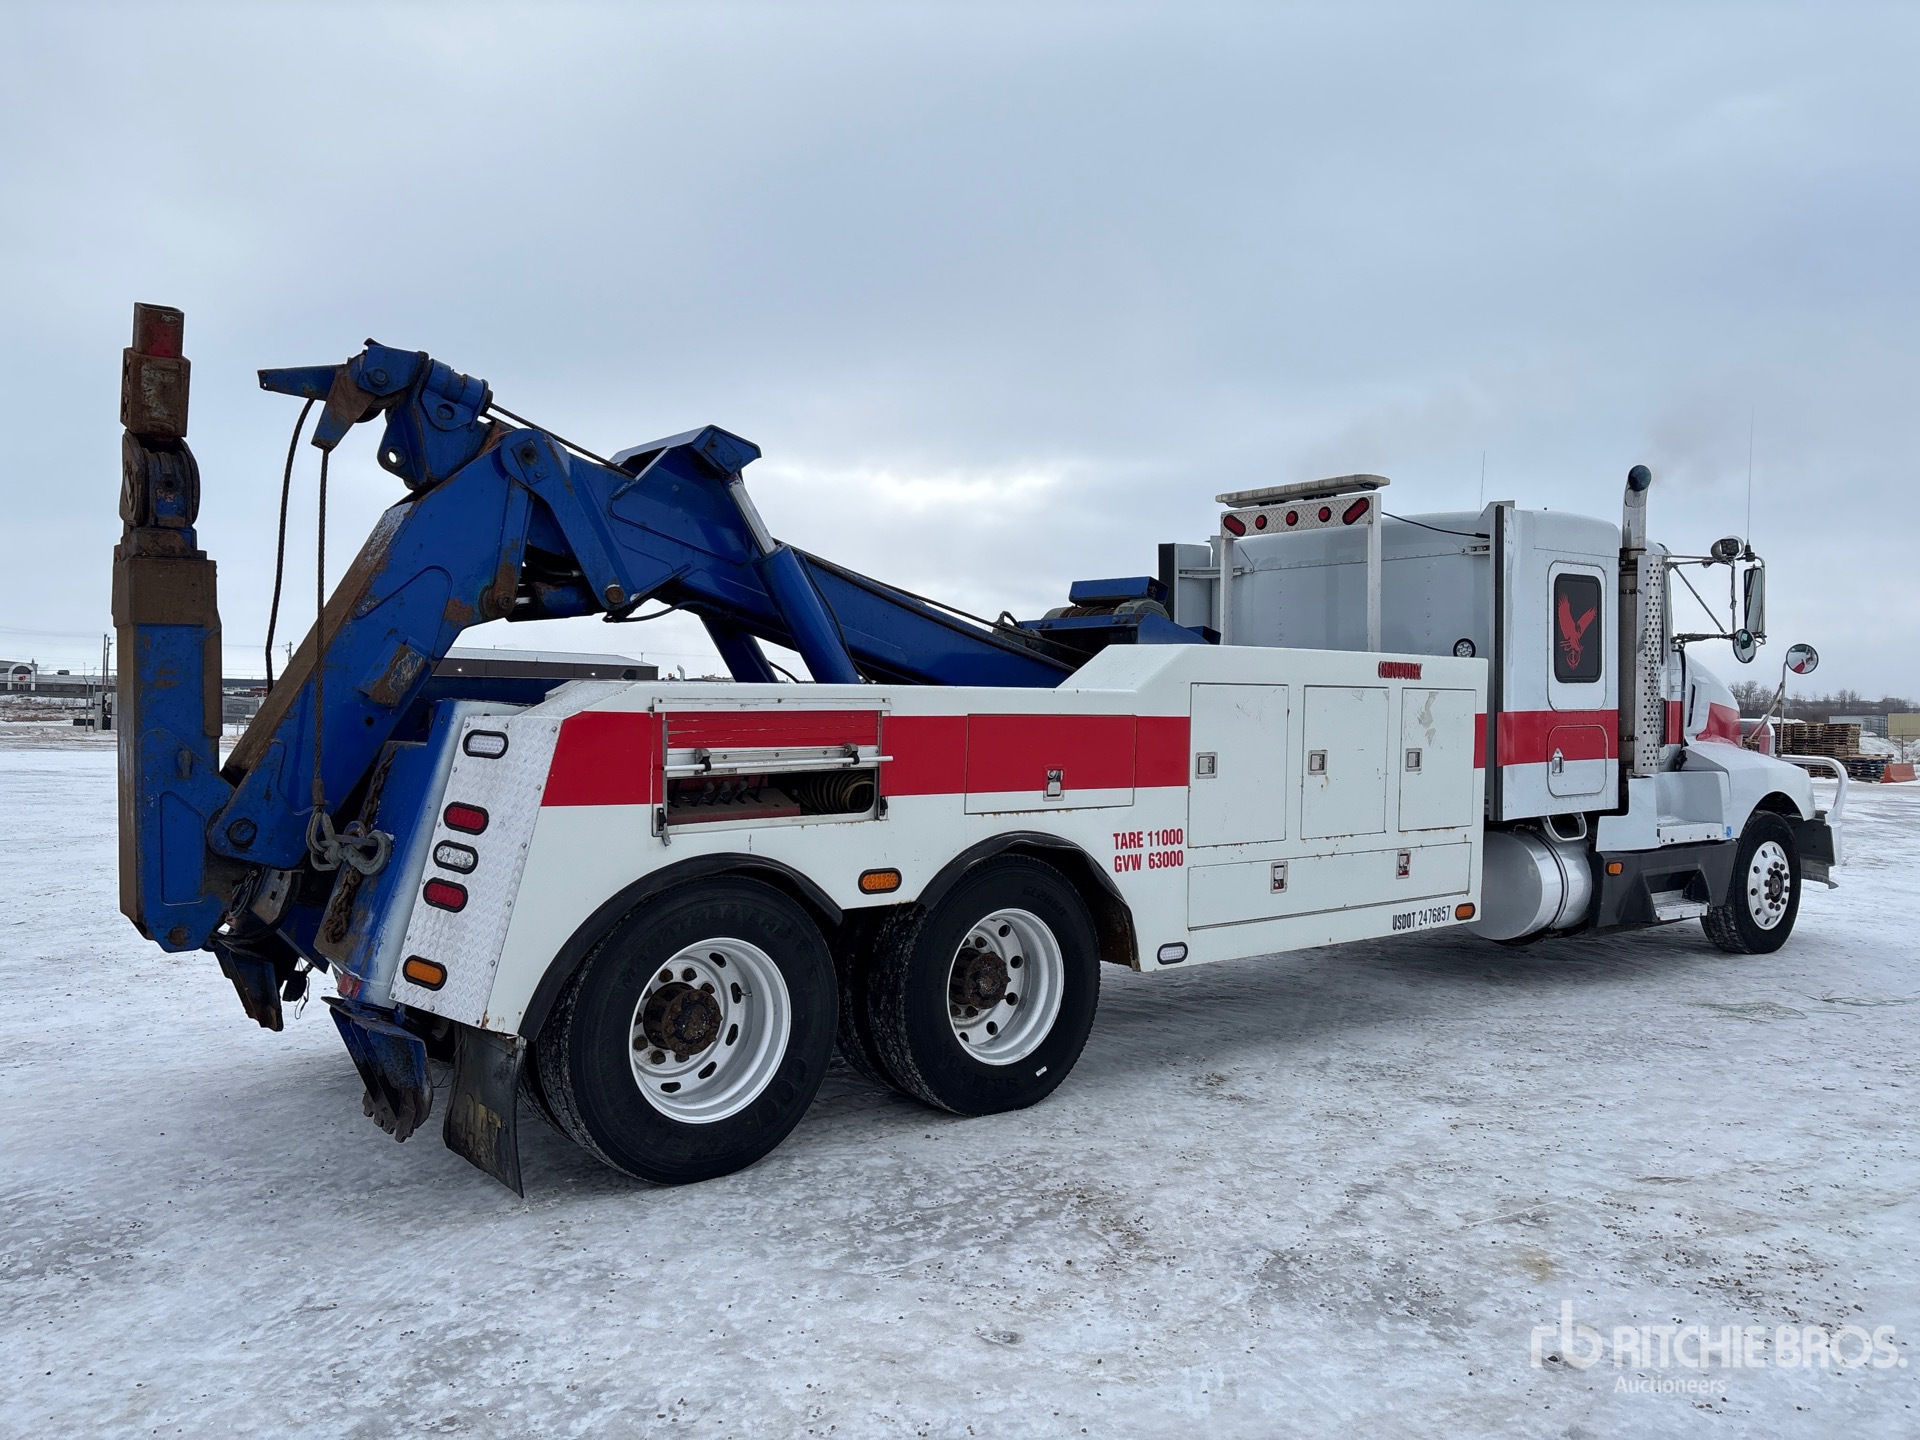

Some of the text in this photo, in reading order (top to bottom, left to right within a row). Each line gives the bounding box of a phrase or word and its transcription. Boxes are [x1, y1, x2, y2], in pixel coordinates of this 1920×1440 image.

[1113, 828, 1183, 850] TARE 11000
[1114, 850, 1184, 873] GVW 63000
[1392, 905, 1451, 931] USDOT 2476857
